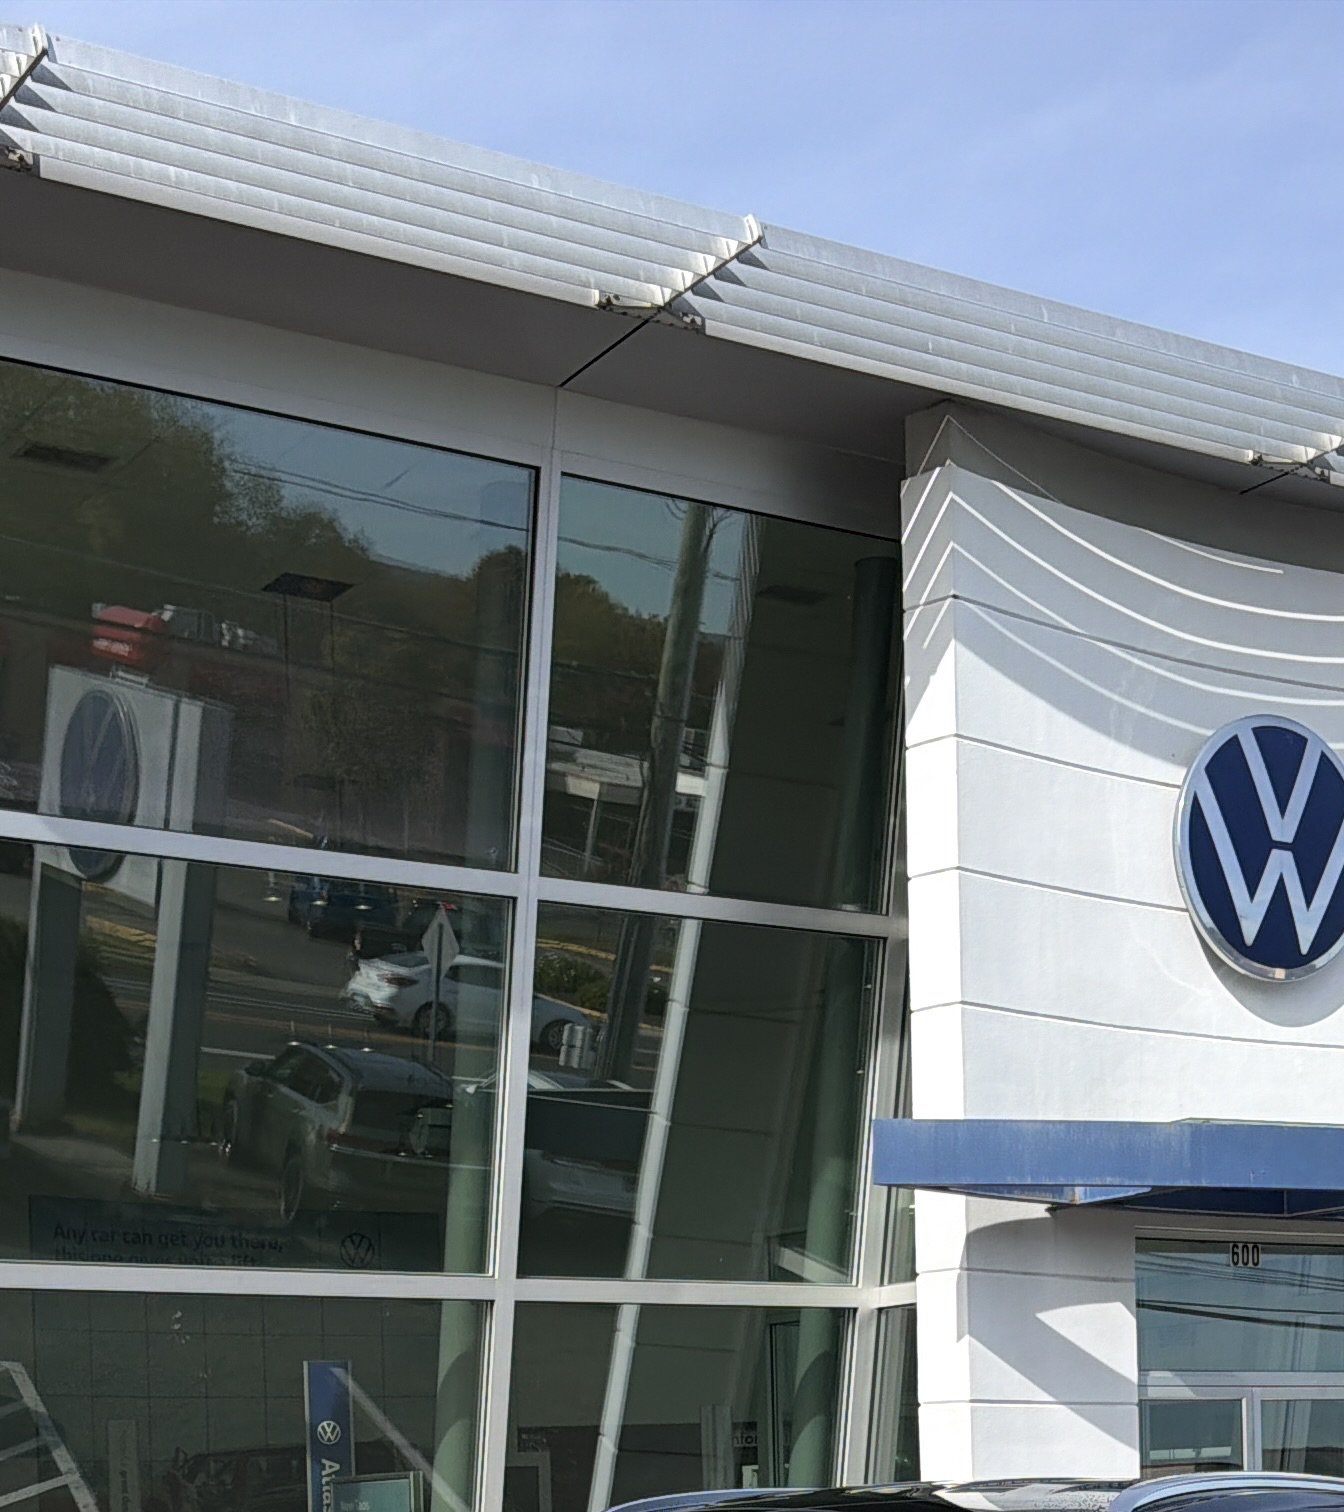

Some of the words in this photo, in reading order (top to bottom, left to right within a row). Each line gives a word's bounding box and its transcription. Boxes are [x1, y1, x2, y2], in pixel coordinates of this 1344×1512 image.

[54, 1222, 86, 1245] Any
[123, 1230, 153, 1246] can
[1231, 1243, 1260, 1267] 600
